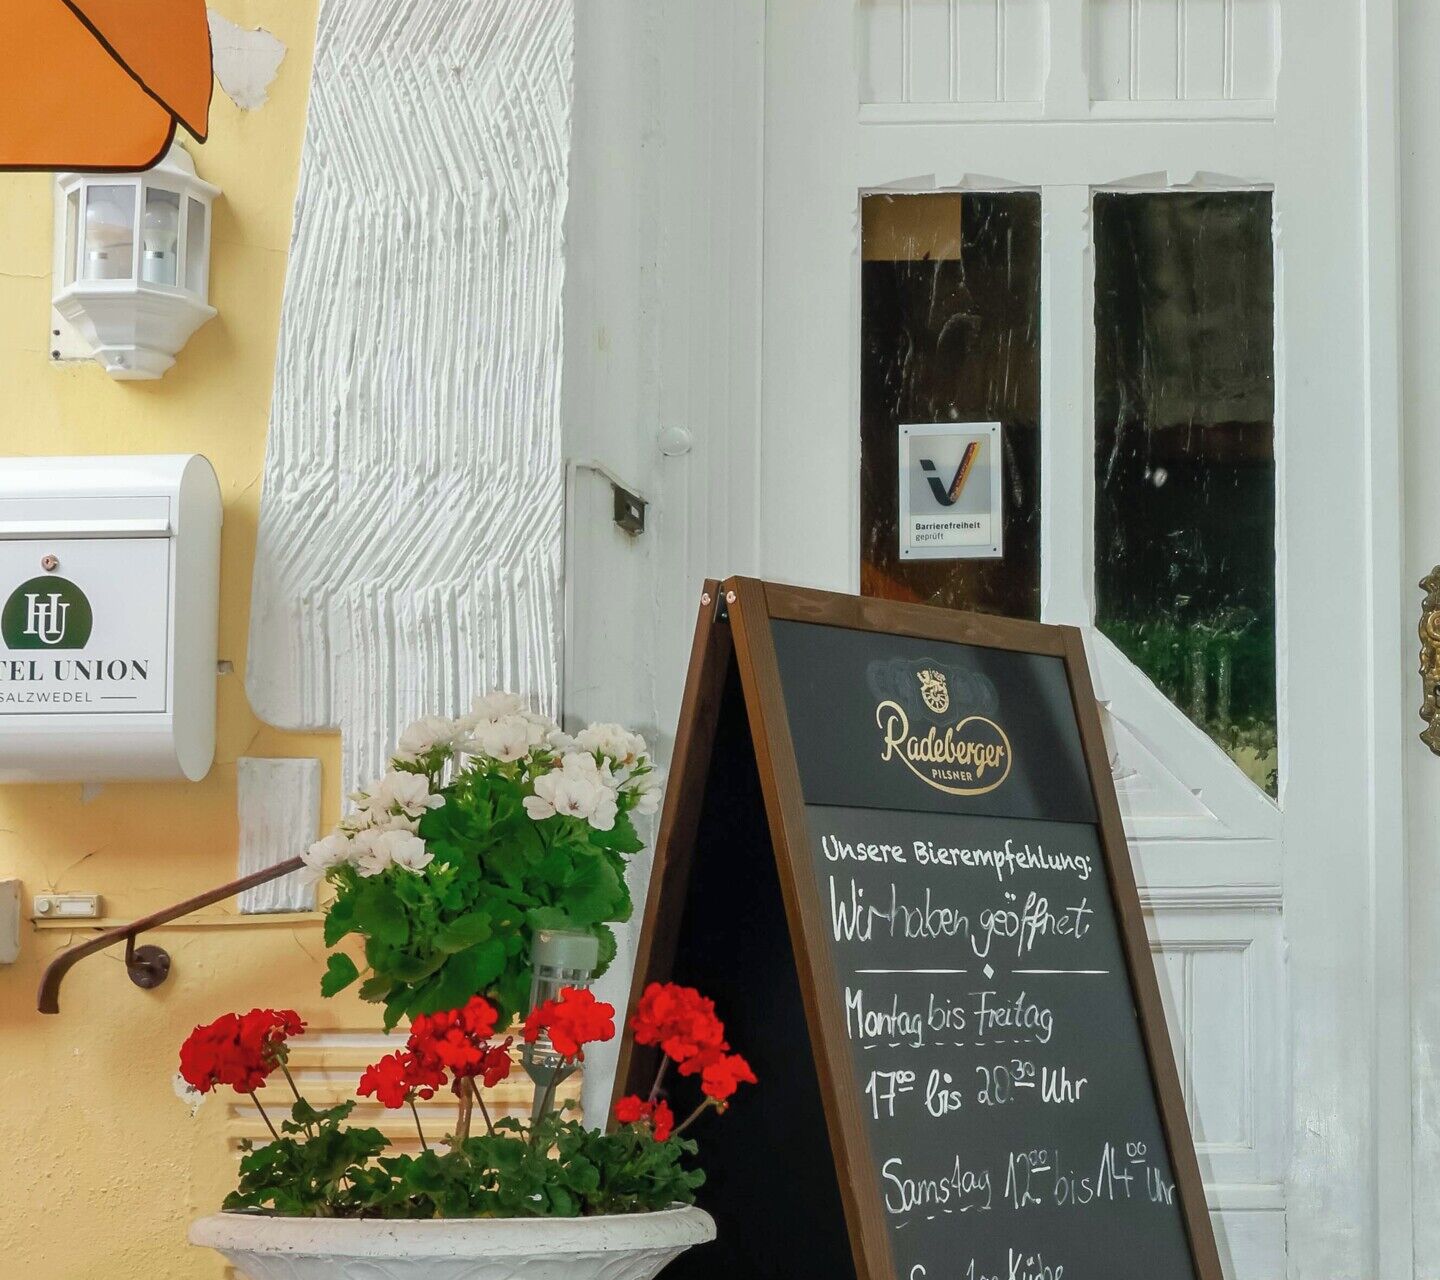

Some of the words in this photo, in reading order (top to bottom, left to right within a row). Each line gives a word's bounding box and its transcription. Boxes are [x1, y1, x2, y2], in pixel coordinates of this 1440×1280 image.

[915, 522, 981, 531] Barrierefreiheit
[915, 532, 944, 542] geprüft
[54, 659, 149, 681] UNION
[876, 700, 1006, 779] Radeberger
[931, 768, 973, 782] PILSNER
[821, 835, 907, 863] Unsere
[912, 838, 1093, 881] Bierempfehlung:
[829, 875, 882, 942] Wir
[845, 986, 923, 1047] Montag
[927, 993, 967, 1031] bis
[968, 990, 1054, 1044] Freitag
[924, 1069, 962, 1118] bis
[1041, 1066, 1089, 1104] Uhr
[882, 1155, 993, 1214] Samstag
[1053, 1149, 1094, 1206] bis
